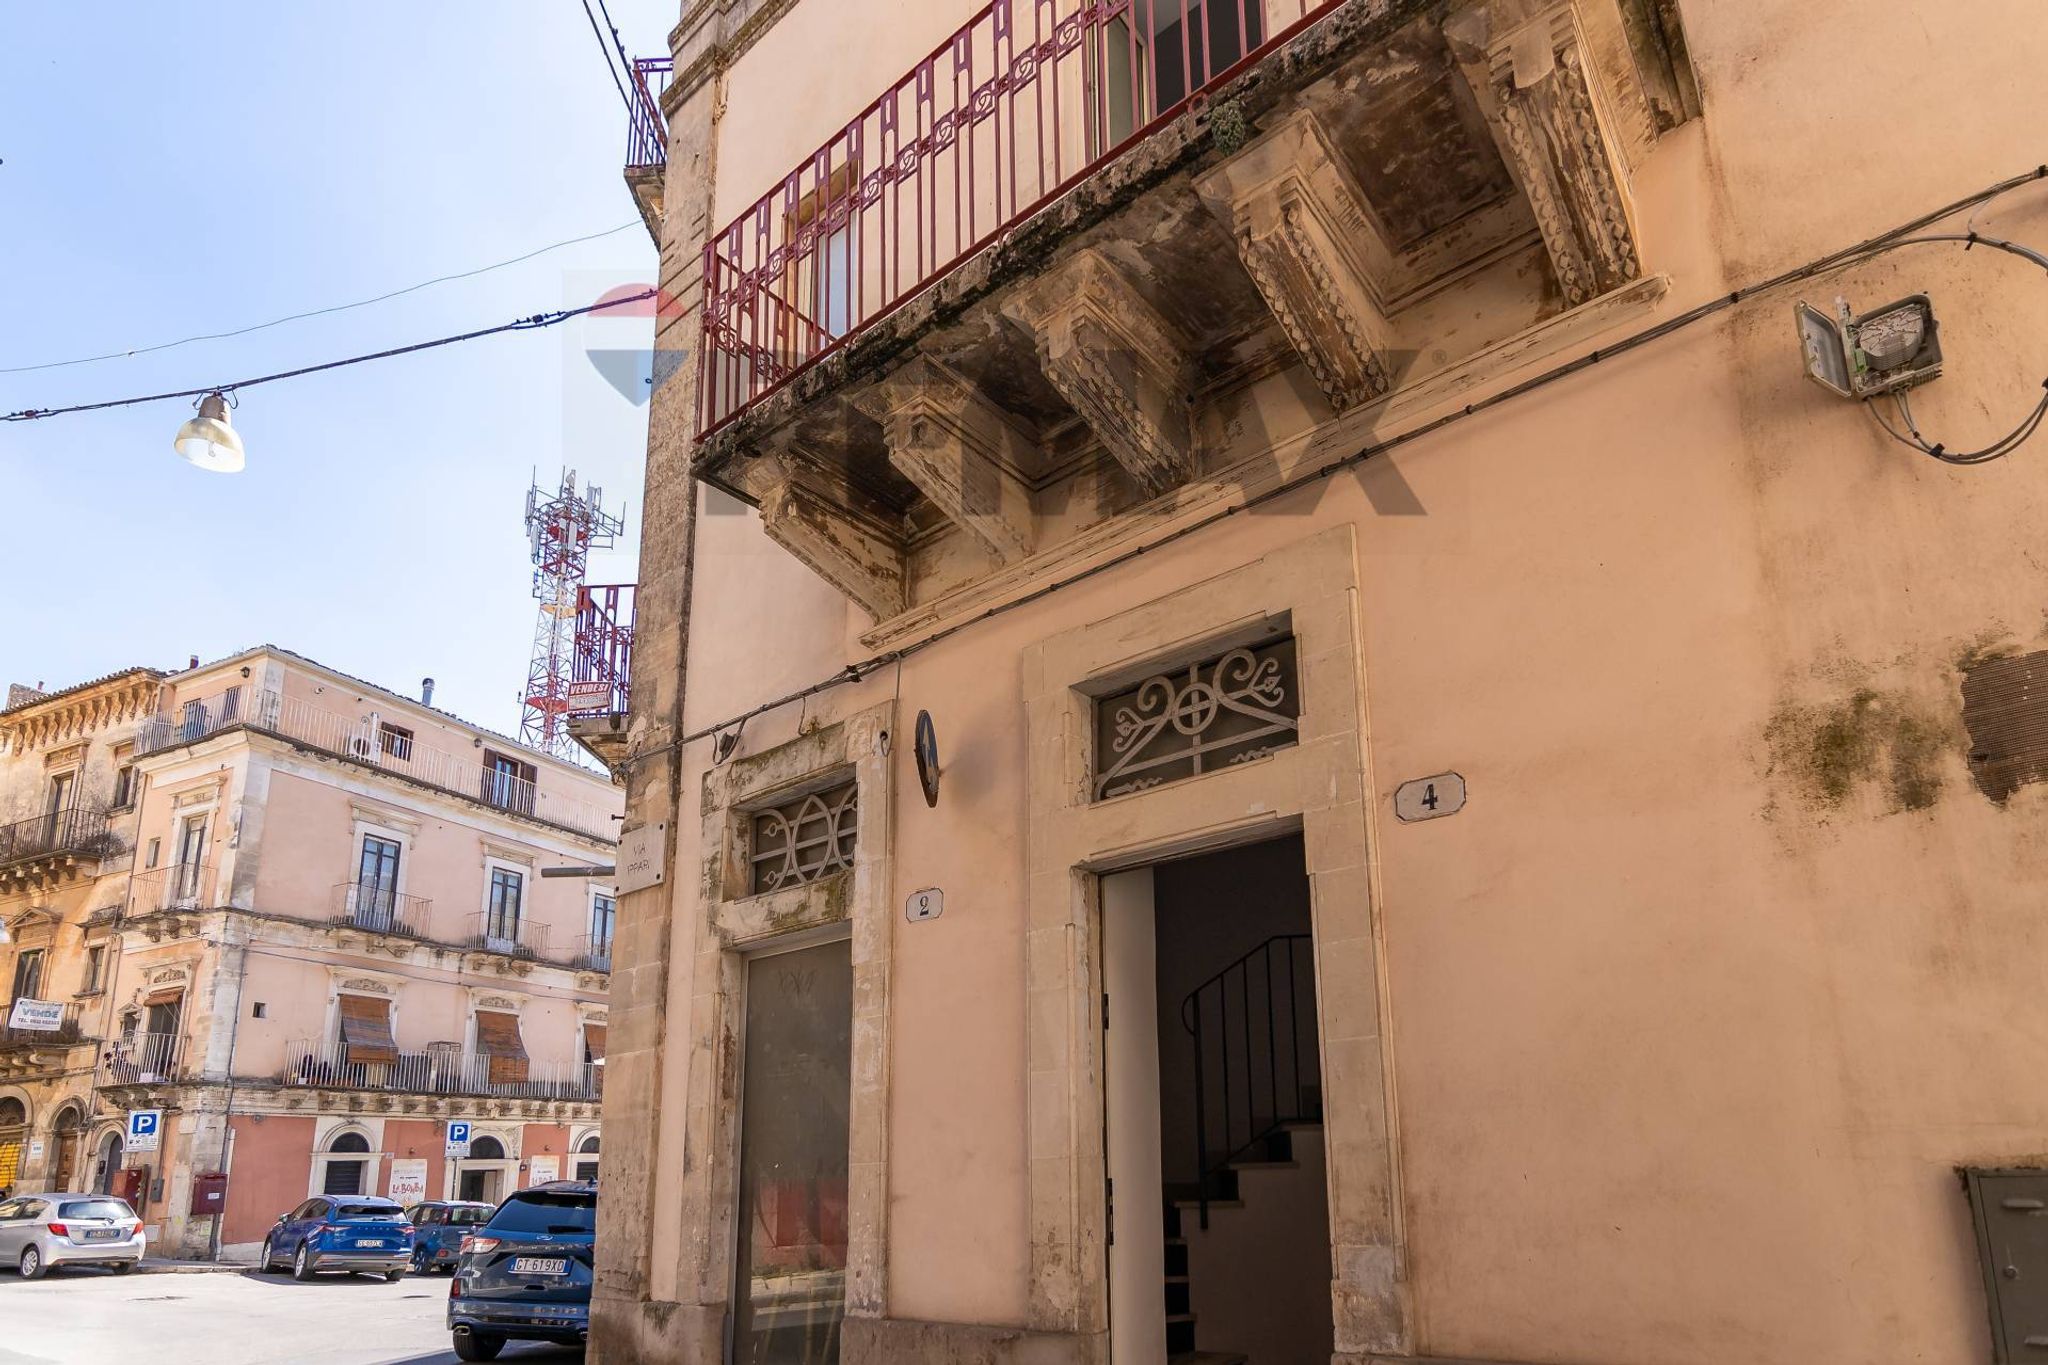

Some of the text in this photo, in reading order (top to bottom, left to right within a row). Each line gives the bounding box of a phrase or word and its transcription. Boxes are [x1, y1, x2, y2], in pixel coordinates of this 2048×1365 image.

[570, 683, 609, 694] VENDESI
[1422, 784, 1438, 810] 4
[632, 841, 647, 857] VIA
[919, 896, 929, 916] 2
[22, 1008, 59, 1018] VENDE
[137, 1115, 153, 1132] P
[453, 1125, 465, 1140] P
